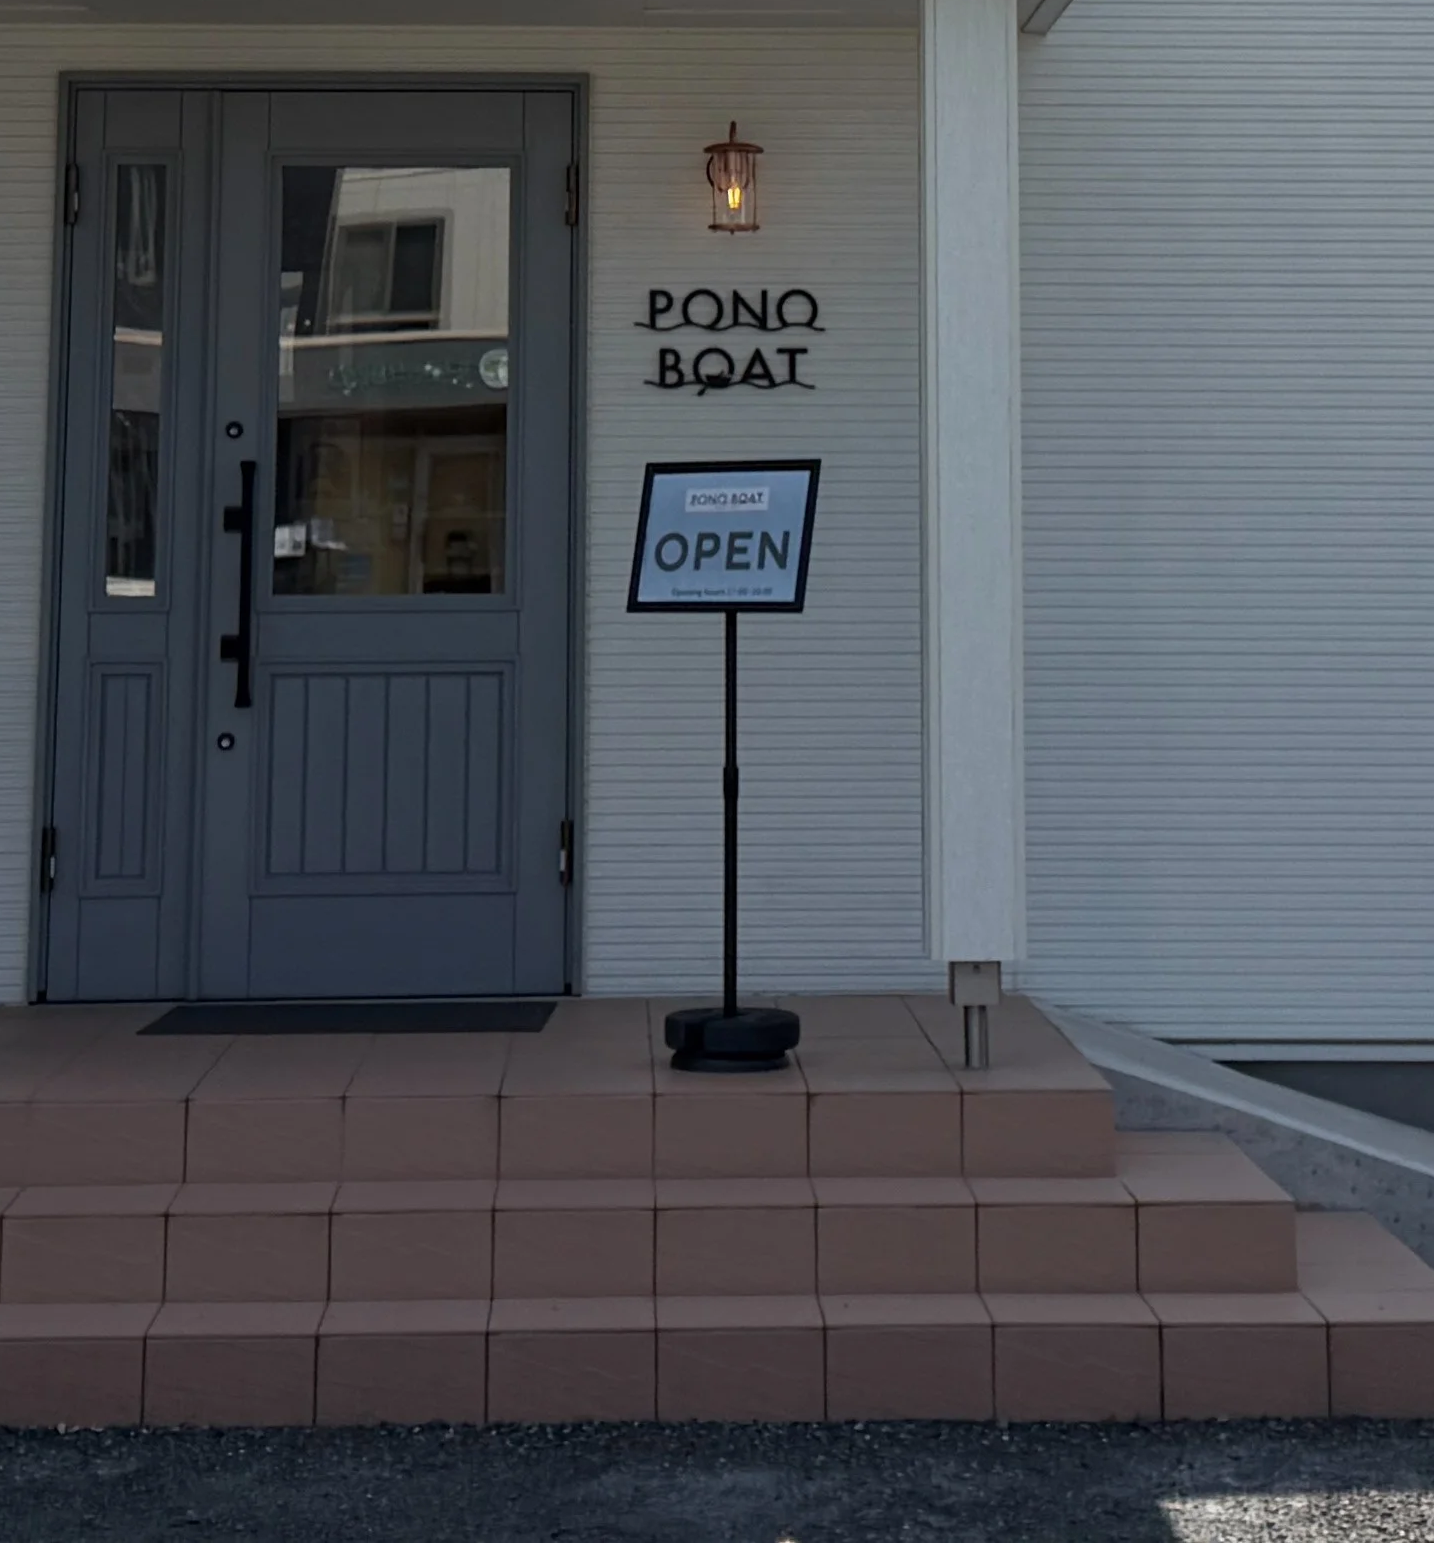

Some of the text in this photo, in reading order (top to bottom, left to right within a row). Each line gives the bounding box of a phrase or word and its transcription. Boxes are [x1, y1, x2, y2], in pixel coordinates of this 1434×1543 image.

[647, 288, 820, 331] PONO
[658, 347, 809, 389] BOAT
[689, 491, 764, 506] PONO BOAT
[654, 530, 791, 572] OPEN
